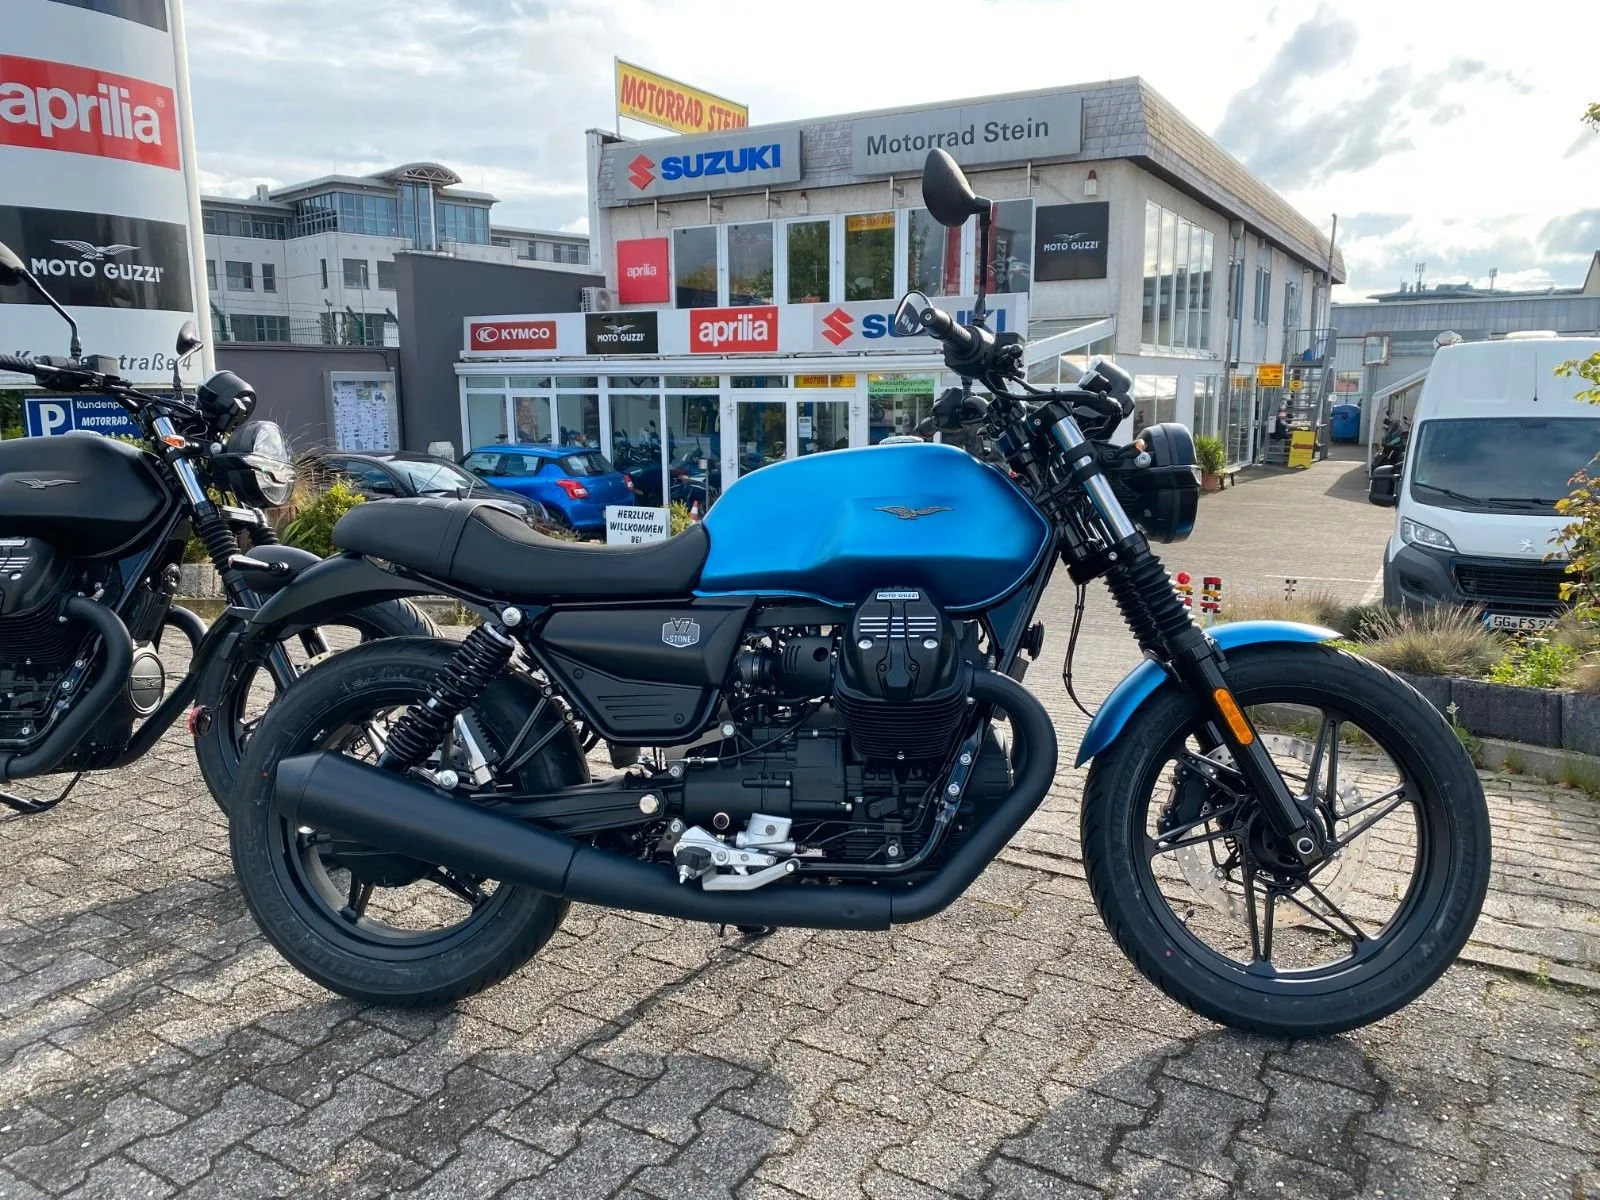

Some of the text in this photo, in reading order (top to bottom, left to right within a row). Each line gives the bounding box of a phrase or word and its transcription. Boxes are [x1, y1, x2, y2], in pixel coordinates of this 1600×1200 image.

[620, 74, 746, 131] MOTORRAD STEIN
[0, 82, 162, 145] aprilia
[867, 118, 1049, 155] Motorrad Stein
[661, 143, 781, 181] SUZUKI
[1044, 240, 1099, 251] MOTO GUZZI
[31, 258, 161, 282] MOTO GUZZI
[626, 264, 657, 279] aprilia
[501, 328, 550, 340] KYMCO
[699, 313, 769, 347] aprilia
[597, 333, 644, 342] MOTO GUZZI
[39, 403, 66, 436] P
[81, 416, 128, 427] MOTORRAD
[618, 509, 654, 520] HERZLICH
[610, 522, 664, 534] WILLKOMMEN
[631, 536, 642, 544] BEI
[671, 617, 694, 632] V7
[1494, 616, 1511, 628] GG
[669, 635, 692, 643] STONE
